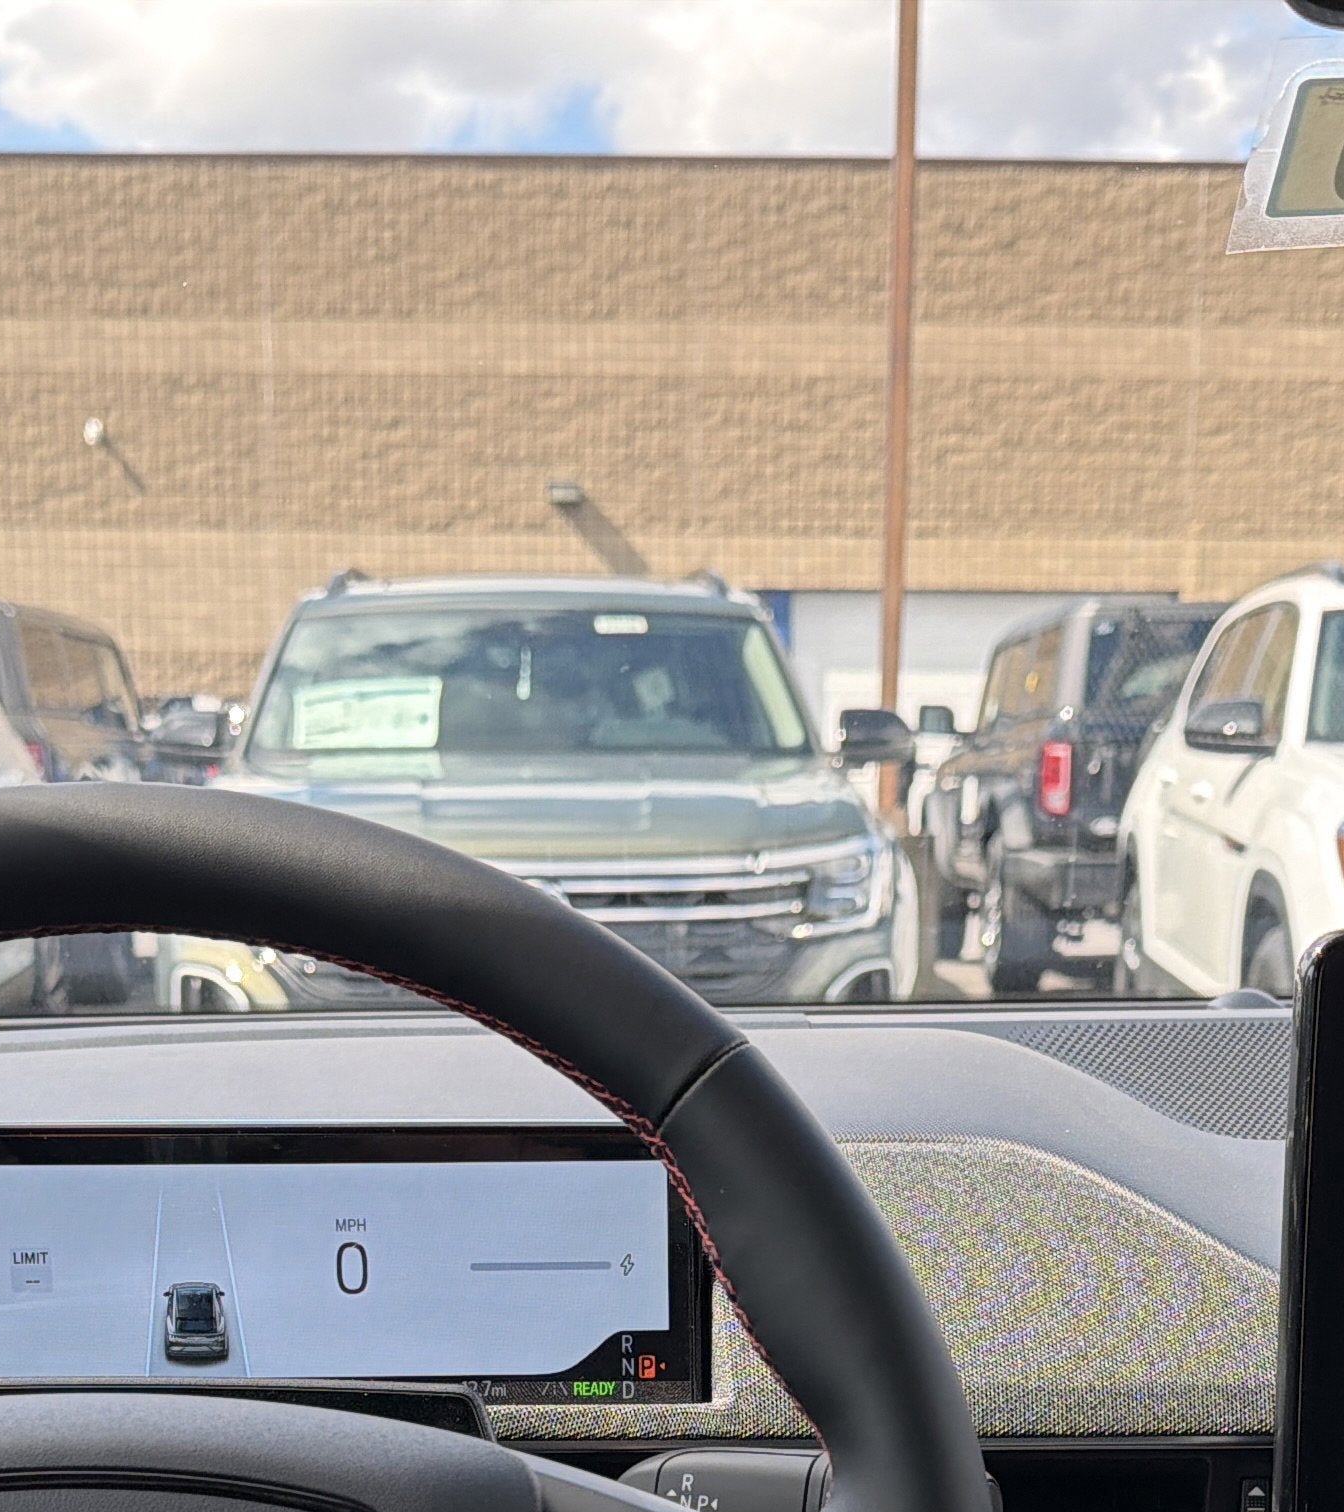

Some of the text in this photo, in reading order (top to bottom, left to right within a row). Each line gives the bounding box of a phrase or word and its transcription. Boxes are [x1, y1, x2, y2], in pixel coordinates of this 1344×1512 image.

[335, 1218, 367, 1233] MPH
[12, 1250, 49, 1266] LIMIT
[336, 1241, 369, 1295] 0
[621, 1334, 634, 1354] R
[622, 1357, 654, 1377] N P
[573, 1381, 616, 1396] READY
[622, 1381, 635, 1399] D
[681, 1473, 694, 1492] R
[680, 1494, 709, 1512] N P
